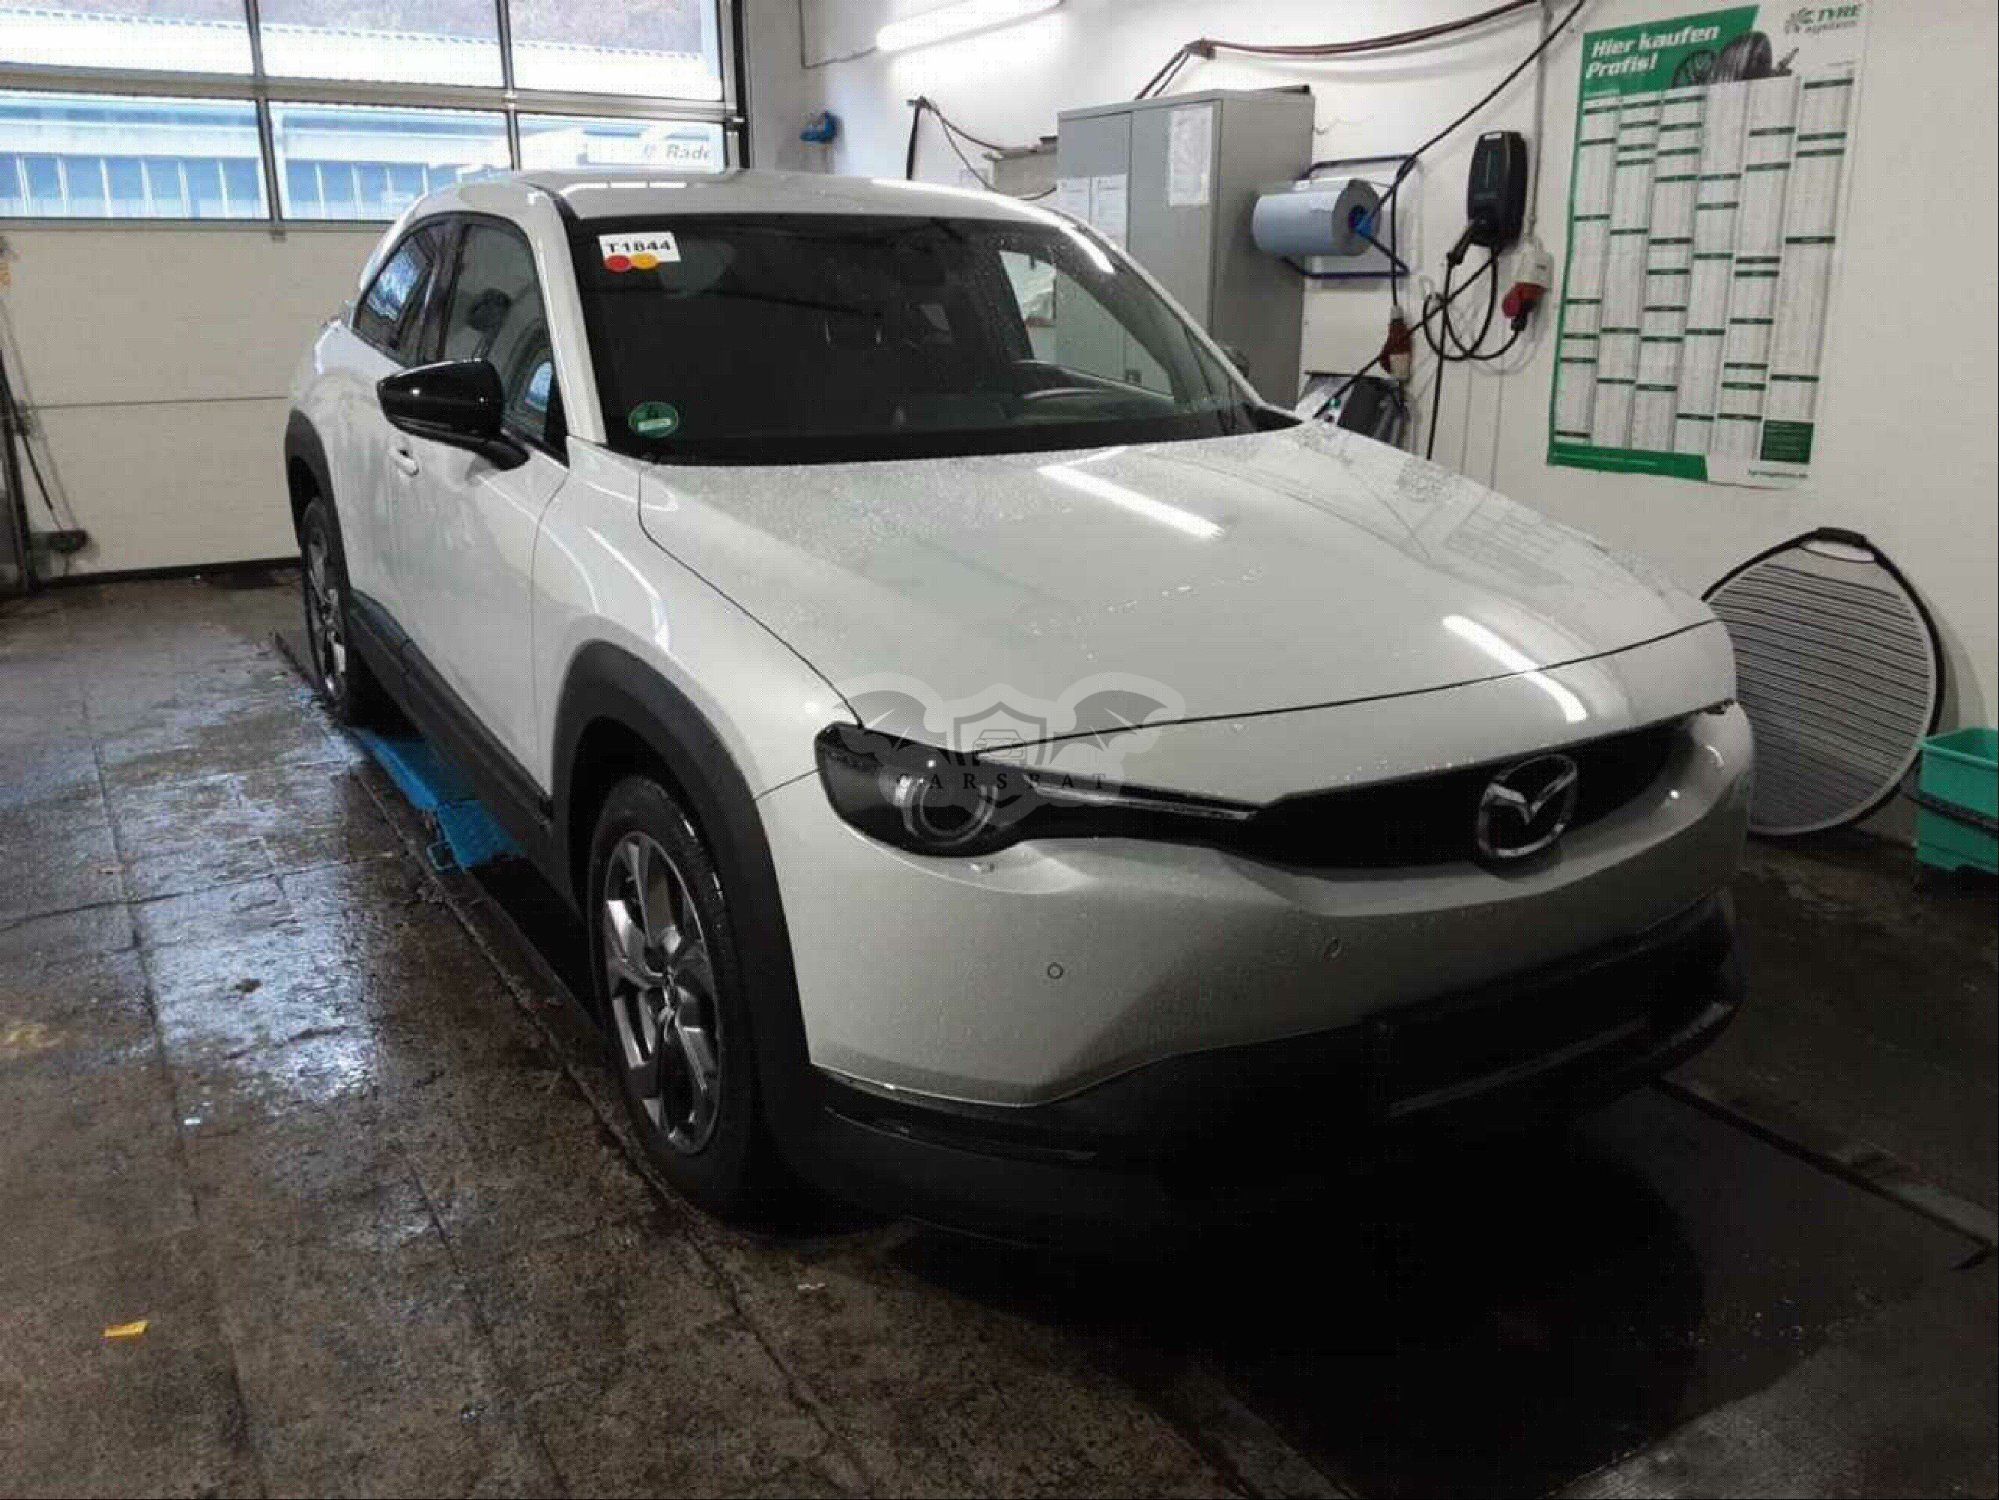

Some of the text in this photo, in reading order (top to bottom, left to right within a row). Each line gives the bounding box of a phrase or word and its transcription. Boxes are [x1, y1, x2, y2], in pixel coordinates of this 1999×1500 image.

[1591, 25, 1721, 58] Hier kaufen
[1585, 52, 1659, 79] Profis!
[606, 239, 671, 254] T1844
